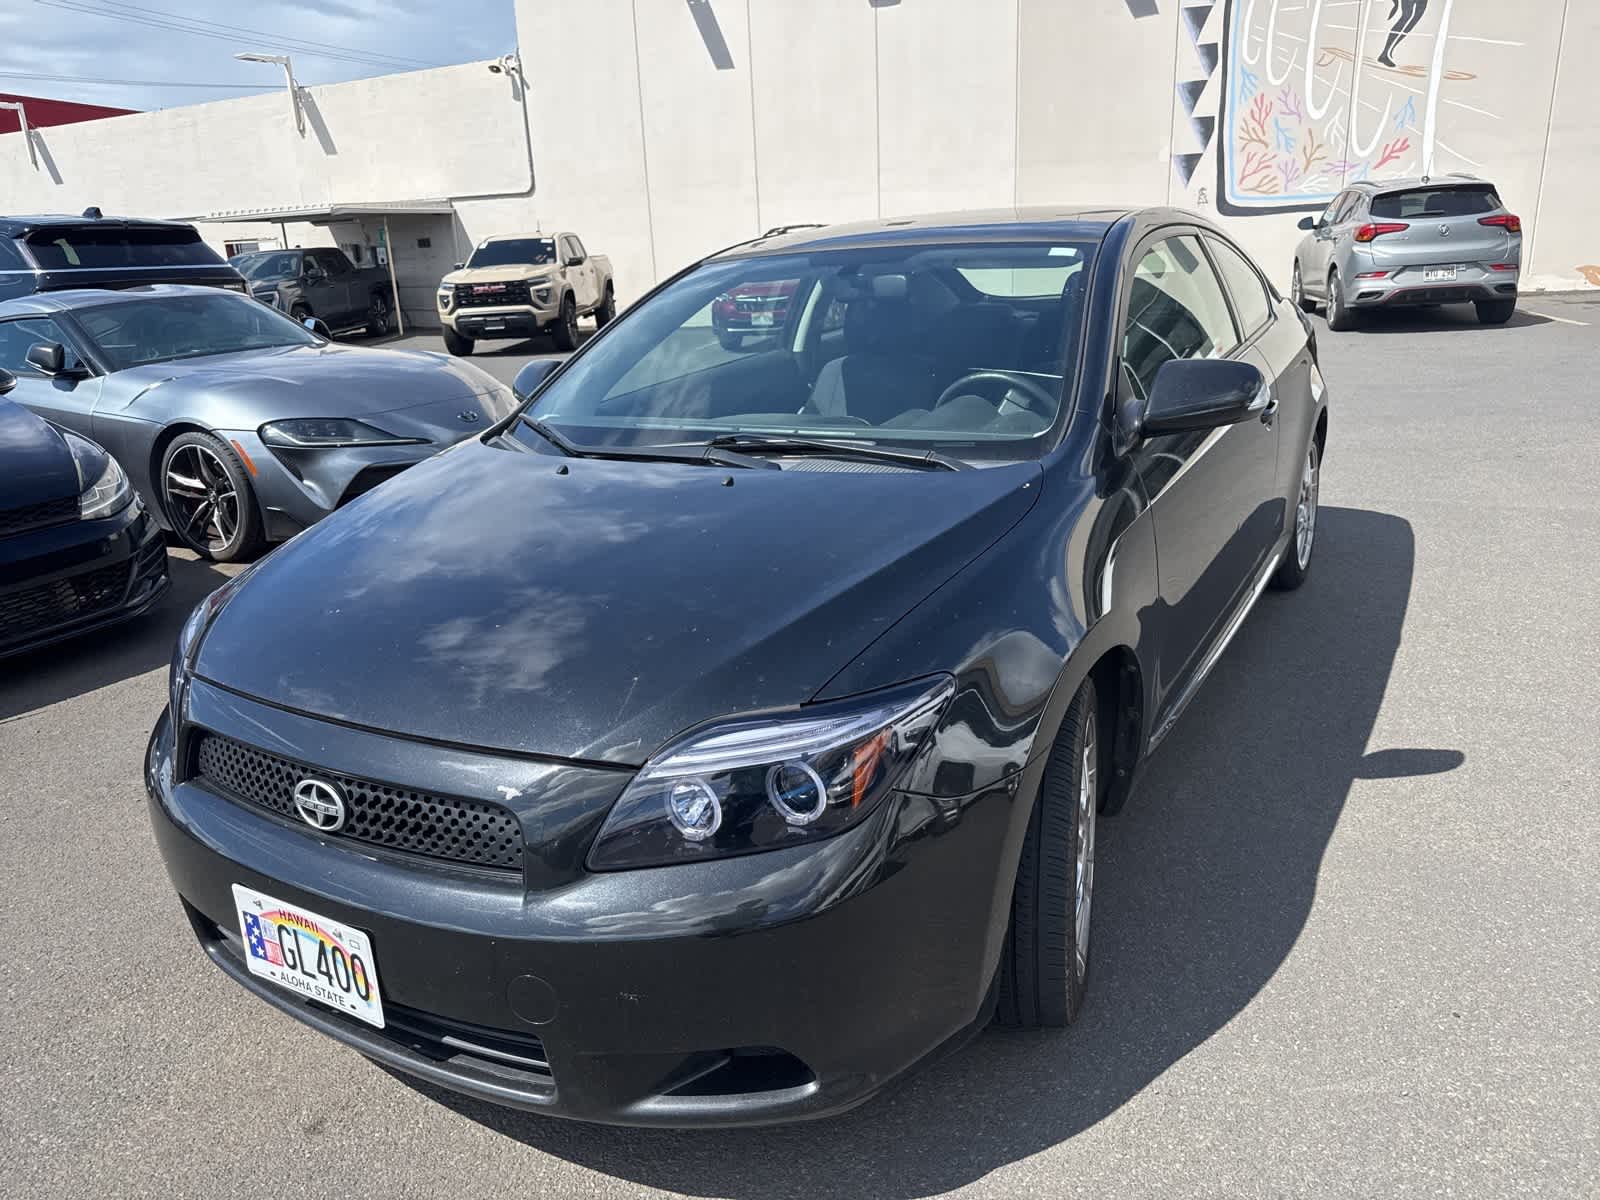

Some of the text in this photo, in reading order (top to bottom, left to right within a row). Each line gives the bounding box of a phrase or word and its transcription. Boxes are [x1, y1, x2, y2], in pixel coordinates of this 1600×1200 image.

[279, 909, 319, 933] HAWAII
[278, 924, 370, 1001] GL400
[280, 972, 345, 1007] ALOHA STATE
